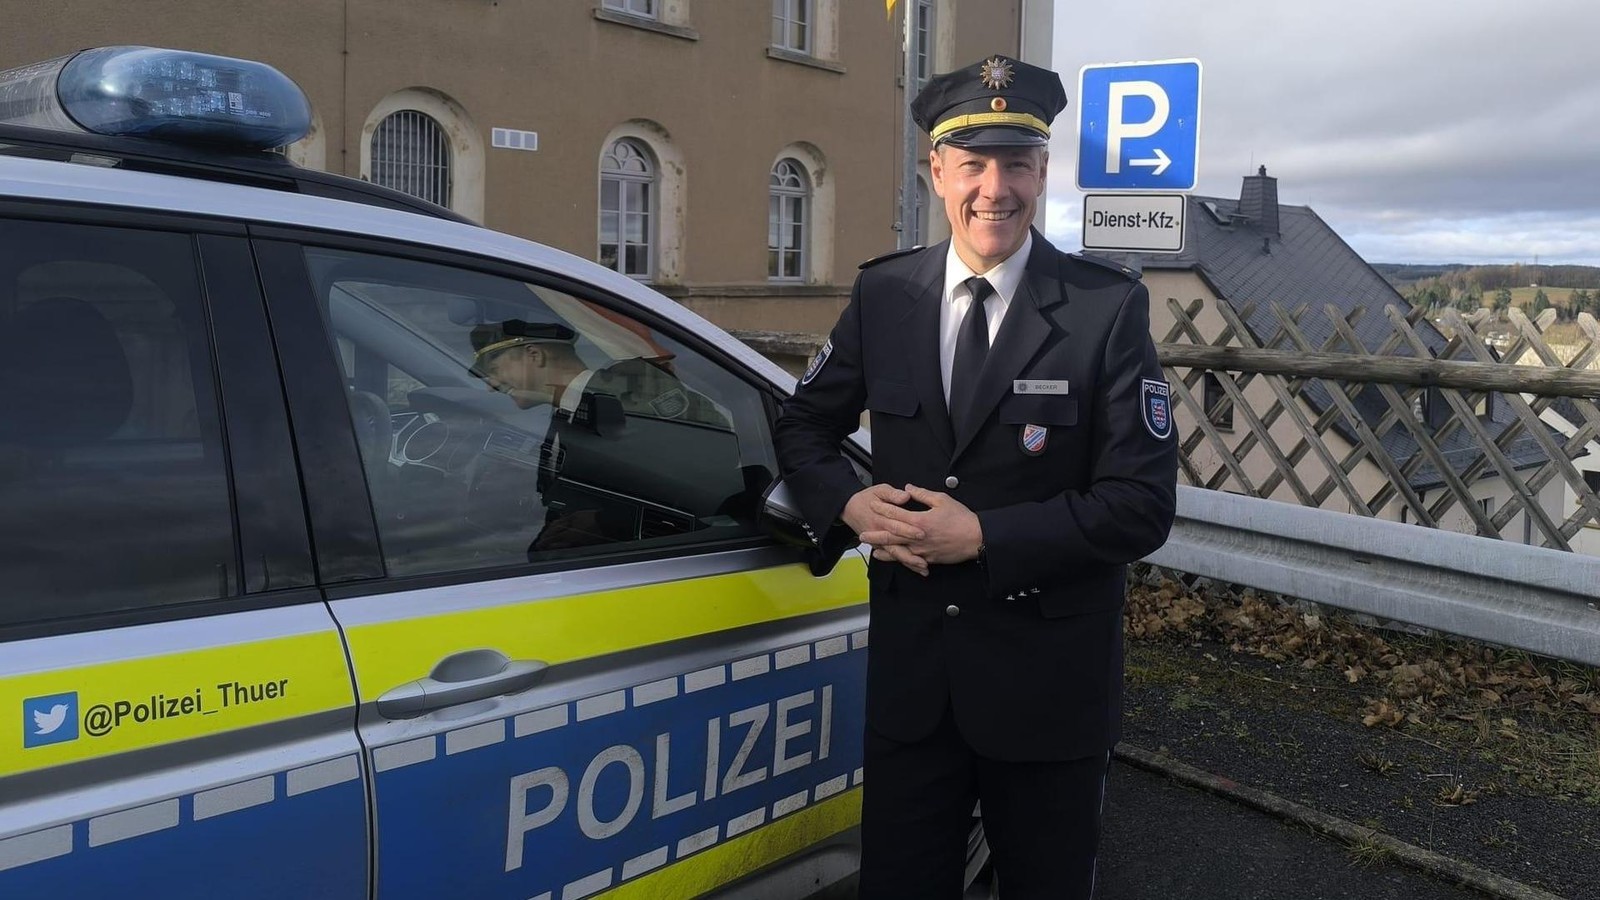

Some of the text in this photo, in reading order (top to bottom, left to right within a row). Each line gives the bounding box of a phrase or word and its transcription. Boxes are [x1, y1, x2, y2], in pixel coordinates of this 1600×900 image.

[1106, 80, 1170, 174] P
[1092, 210, 1174, 229] Dienst-Kfz
[1144, 384, 1168, 396] POLIZEI
[84, 678, 288, 737] @Polizei_Thuer
[505, 684, 833, 873] POLIZEI
